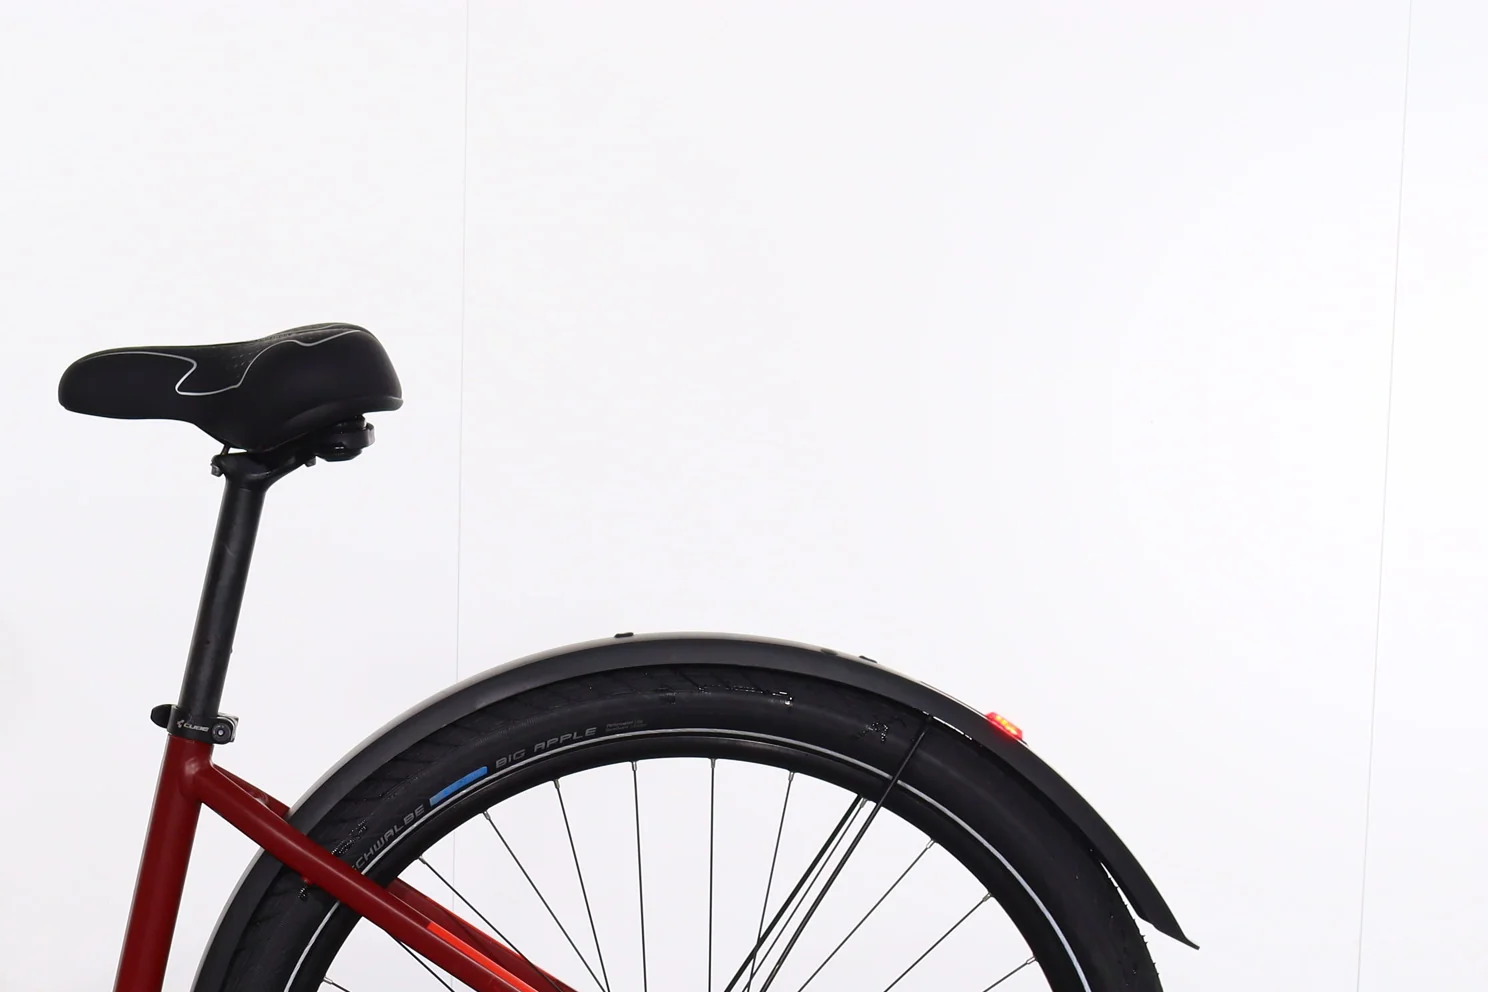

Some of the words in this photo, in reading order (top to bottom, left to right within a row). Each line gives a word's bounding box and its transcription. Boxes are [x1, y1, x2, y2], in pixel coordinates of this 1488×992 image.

[183, 722, 210, 732] CUBE
[352, 804, 425, 870] CHWALBE
[495, 747, 526, 769] BIG
[533, 726, 597, 752] APPLE
